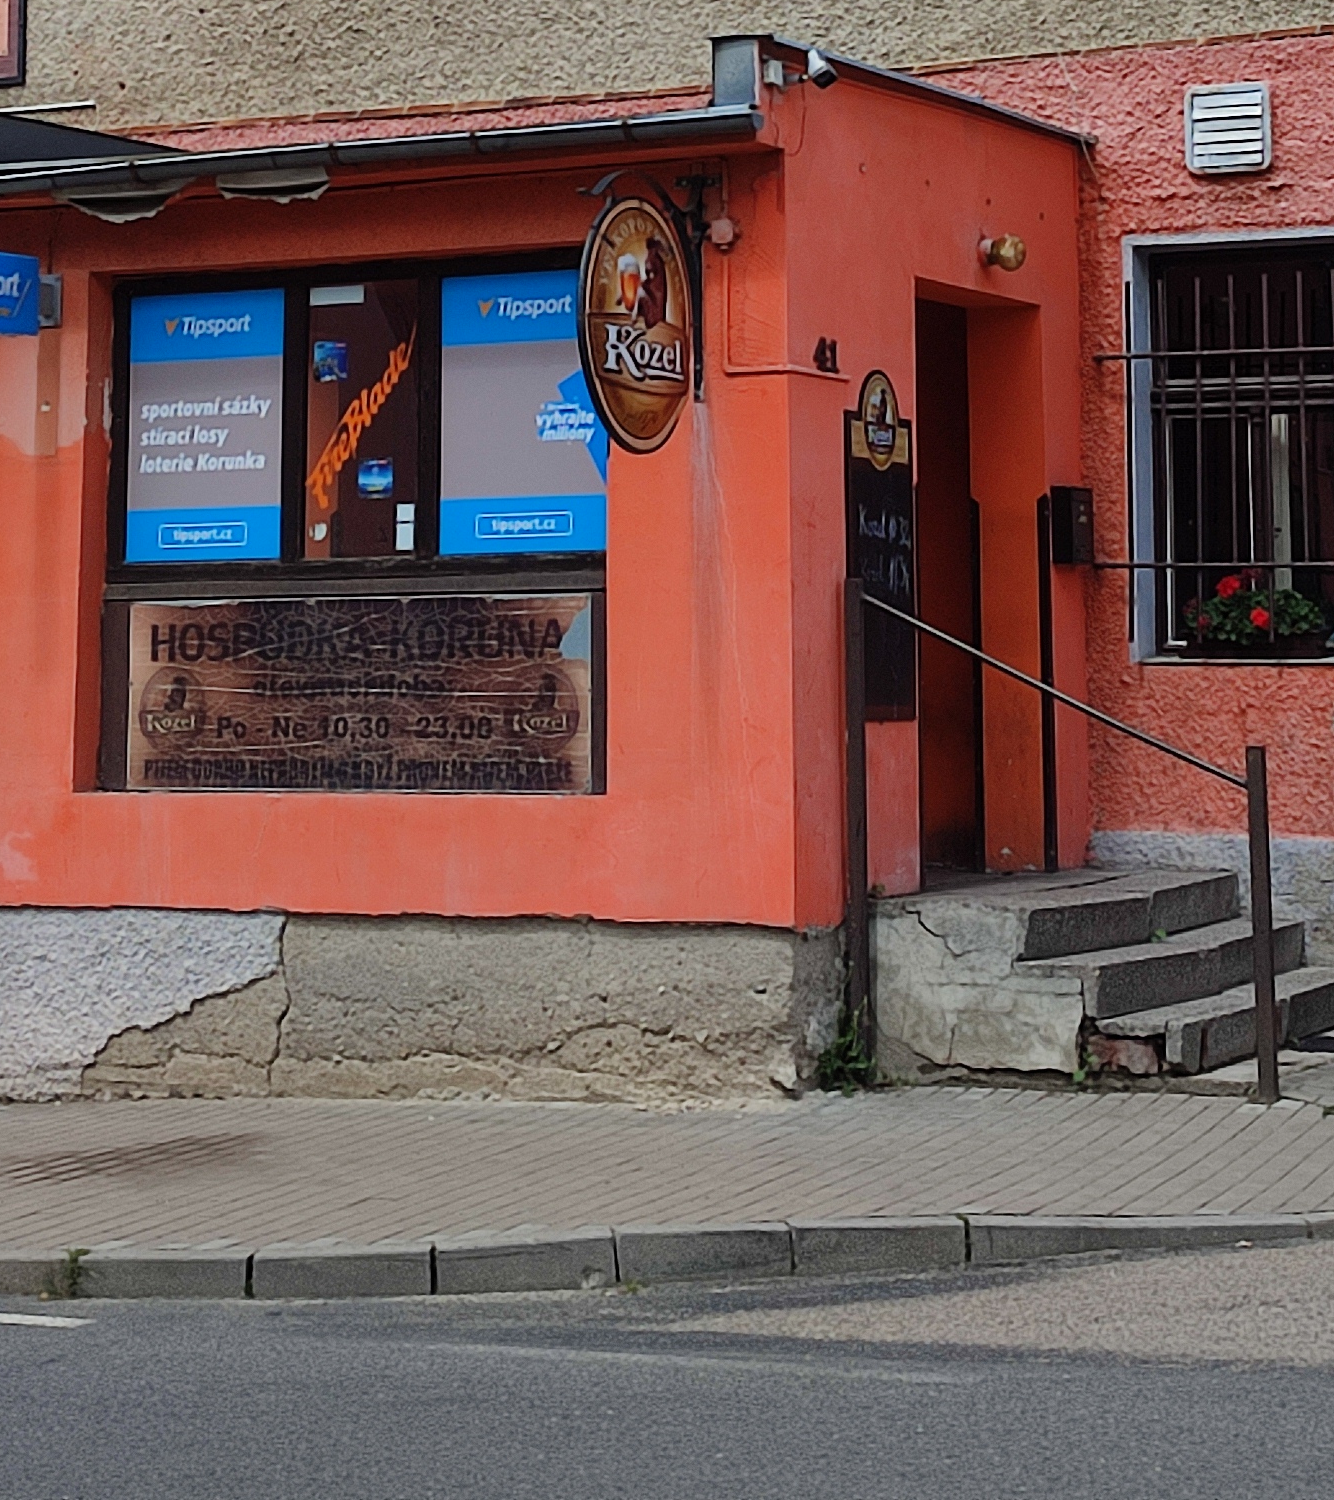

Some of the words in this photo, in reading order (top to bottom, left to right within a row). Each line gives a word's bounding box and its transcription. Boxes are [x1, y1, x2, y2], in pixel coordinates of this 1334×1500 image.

[497, 294, 572, 320] Tipsport
[181, 314, 251, 339] Tipsport
[603, 324, 684, 381] Kozel
[141, 398, 219, 423] sportovní
[222, 395, 271, 419] sázky
[140, 426, 193, 447] stírací
[193, 425, 229, 447] losy
[139, 453, 193, 474] loterie
[197, 450, 266, 472] Korunka
[173, 527, 233, 543] tipsport.cz
[491, 517, 556, 534] tipsport.cz
[147, 714, 195, 733] Kozel
[217, 717, 247, 739] Po
[271, 716, 307, 740] Ne
